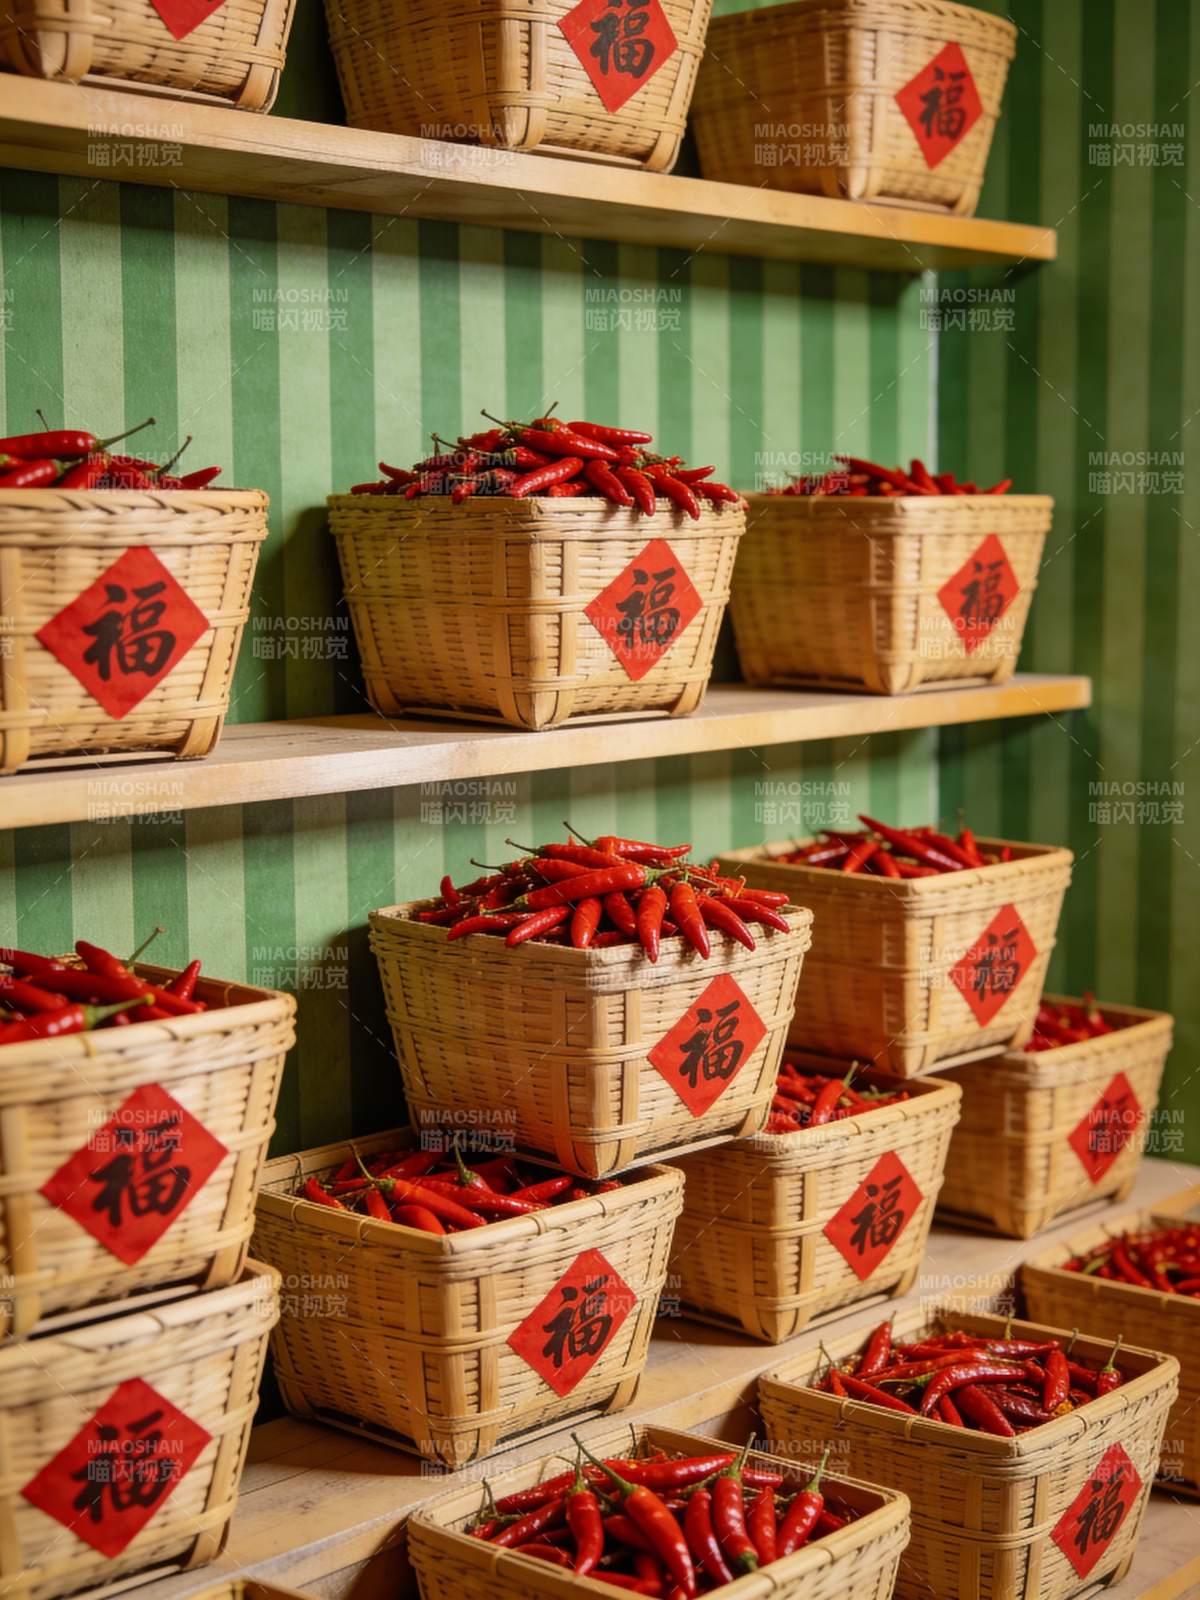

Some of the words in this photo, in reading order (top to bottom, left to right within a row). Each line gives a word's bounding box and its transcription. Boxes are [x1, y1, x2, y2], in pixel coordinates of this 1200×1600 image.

[590, 0, 655, 78] 福
[919, 66, 966, 141] 福
[81, 581, 176, 681] 福
[616, 567, 680, 648] 福
[959, 560, 1004, 628] 福
[679, 1001, 744, 1088] 福
[88, 1117, 191, 1227] 福
[850, 1176, 904, 1254] 福
[542, 1275, 613, 1368] 福
[70, 1410, 175, 1525] 福
[1074, 1465, 1125, 1555] 福
